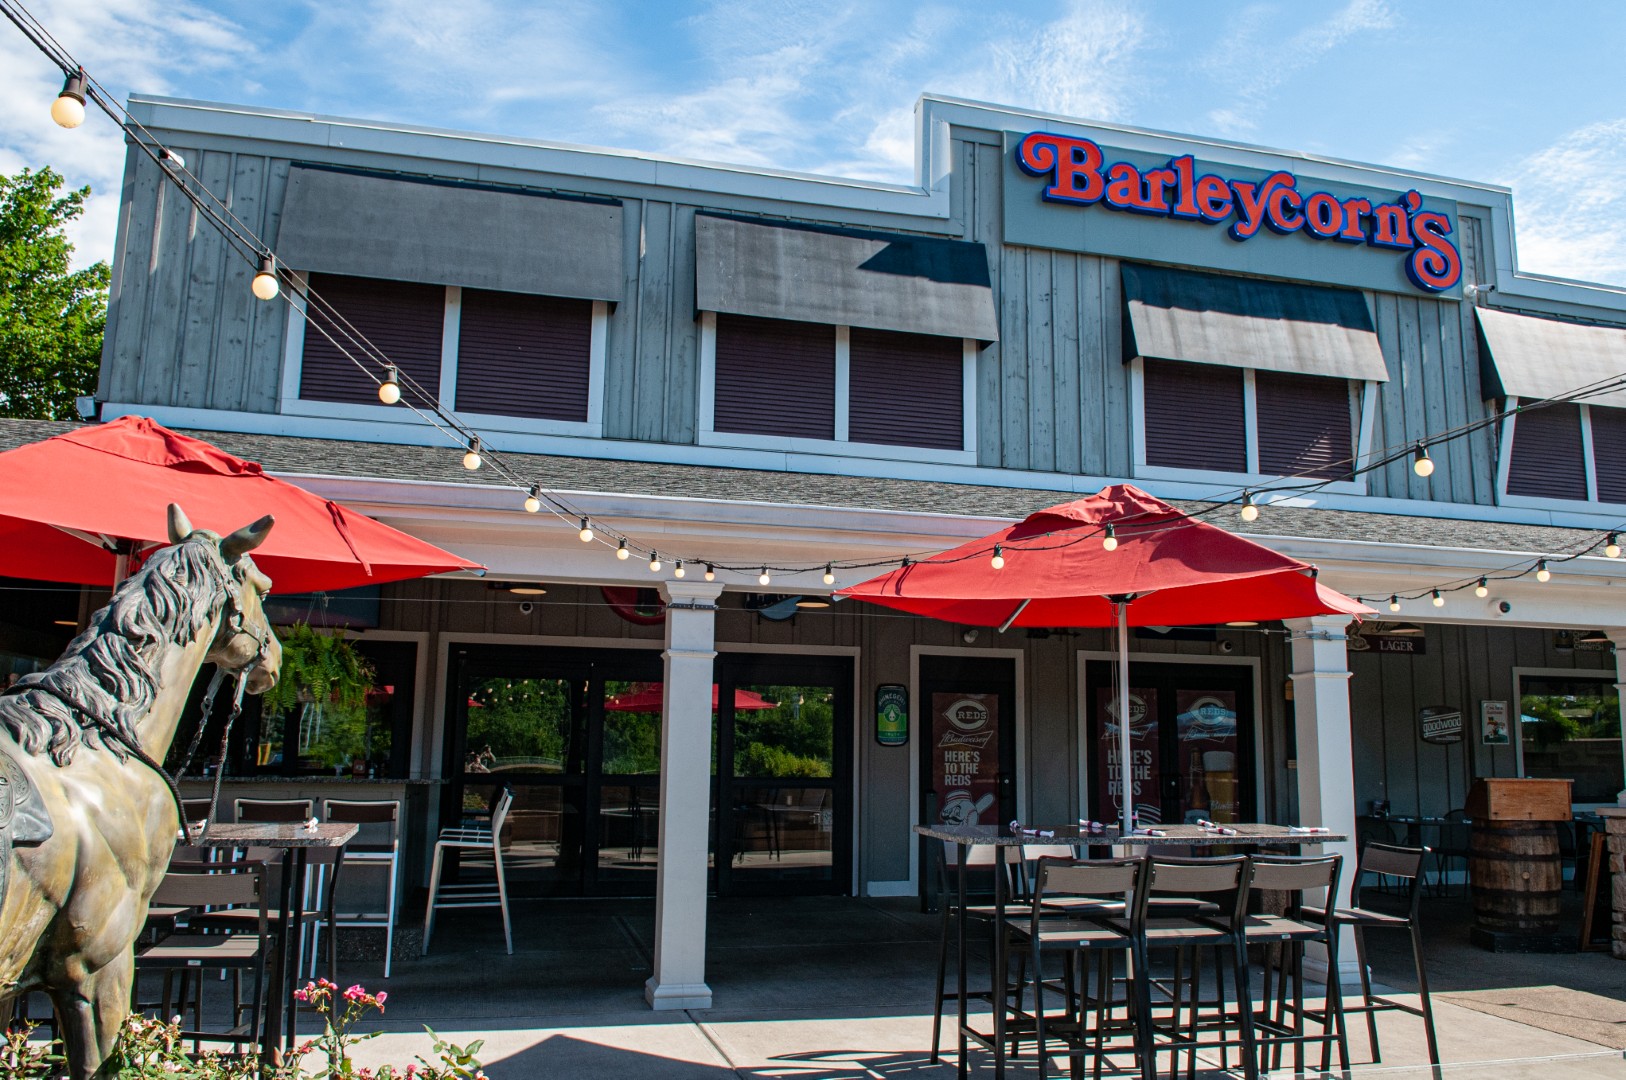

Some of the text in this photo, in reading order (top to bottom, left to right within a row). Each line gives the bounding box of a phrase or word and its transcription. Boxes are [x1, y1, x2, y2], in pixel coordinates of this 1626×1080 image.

[1016, 131, 1463, 294] Barleycorn's
[1379, 640, 1414, 652] LAGER
[957, 710, 987, 721] REDS
[1200, 707, 1226, 717] REDS
[1423, 714, 1462, 738] goodwood
[944, 732, 988, 745] Budweiser
[944, 750, 981, 763] HERE'S
[1107, 749, 1153, 765] HEE'S
[944, 763, 979, 774] TO THE
[944, 774, 972, 786] REDS
[1107, 781, 1142, 796] RES
